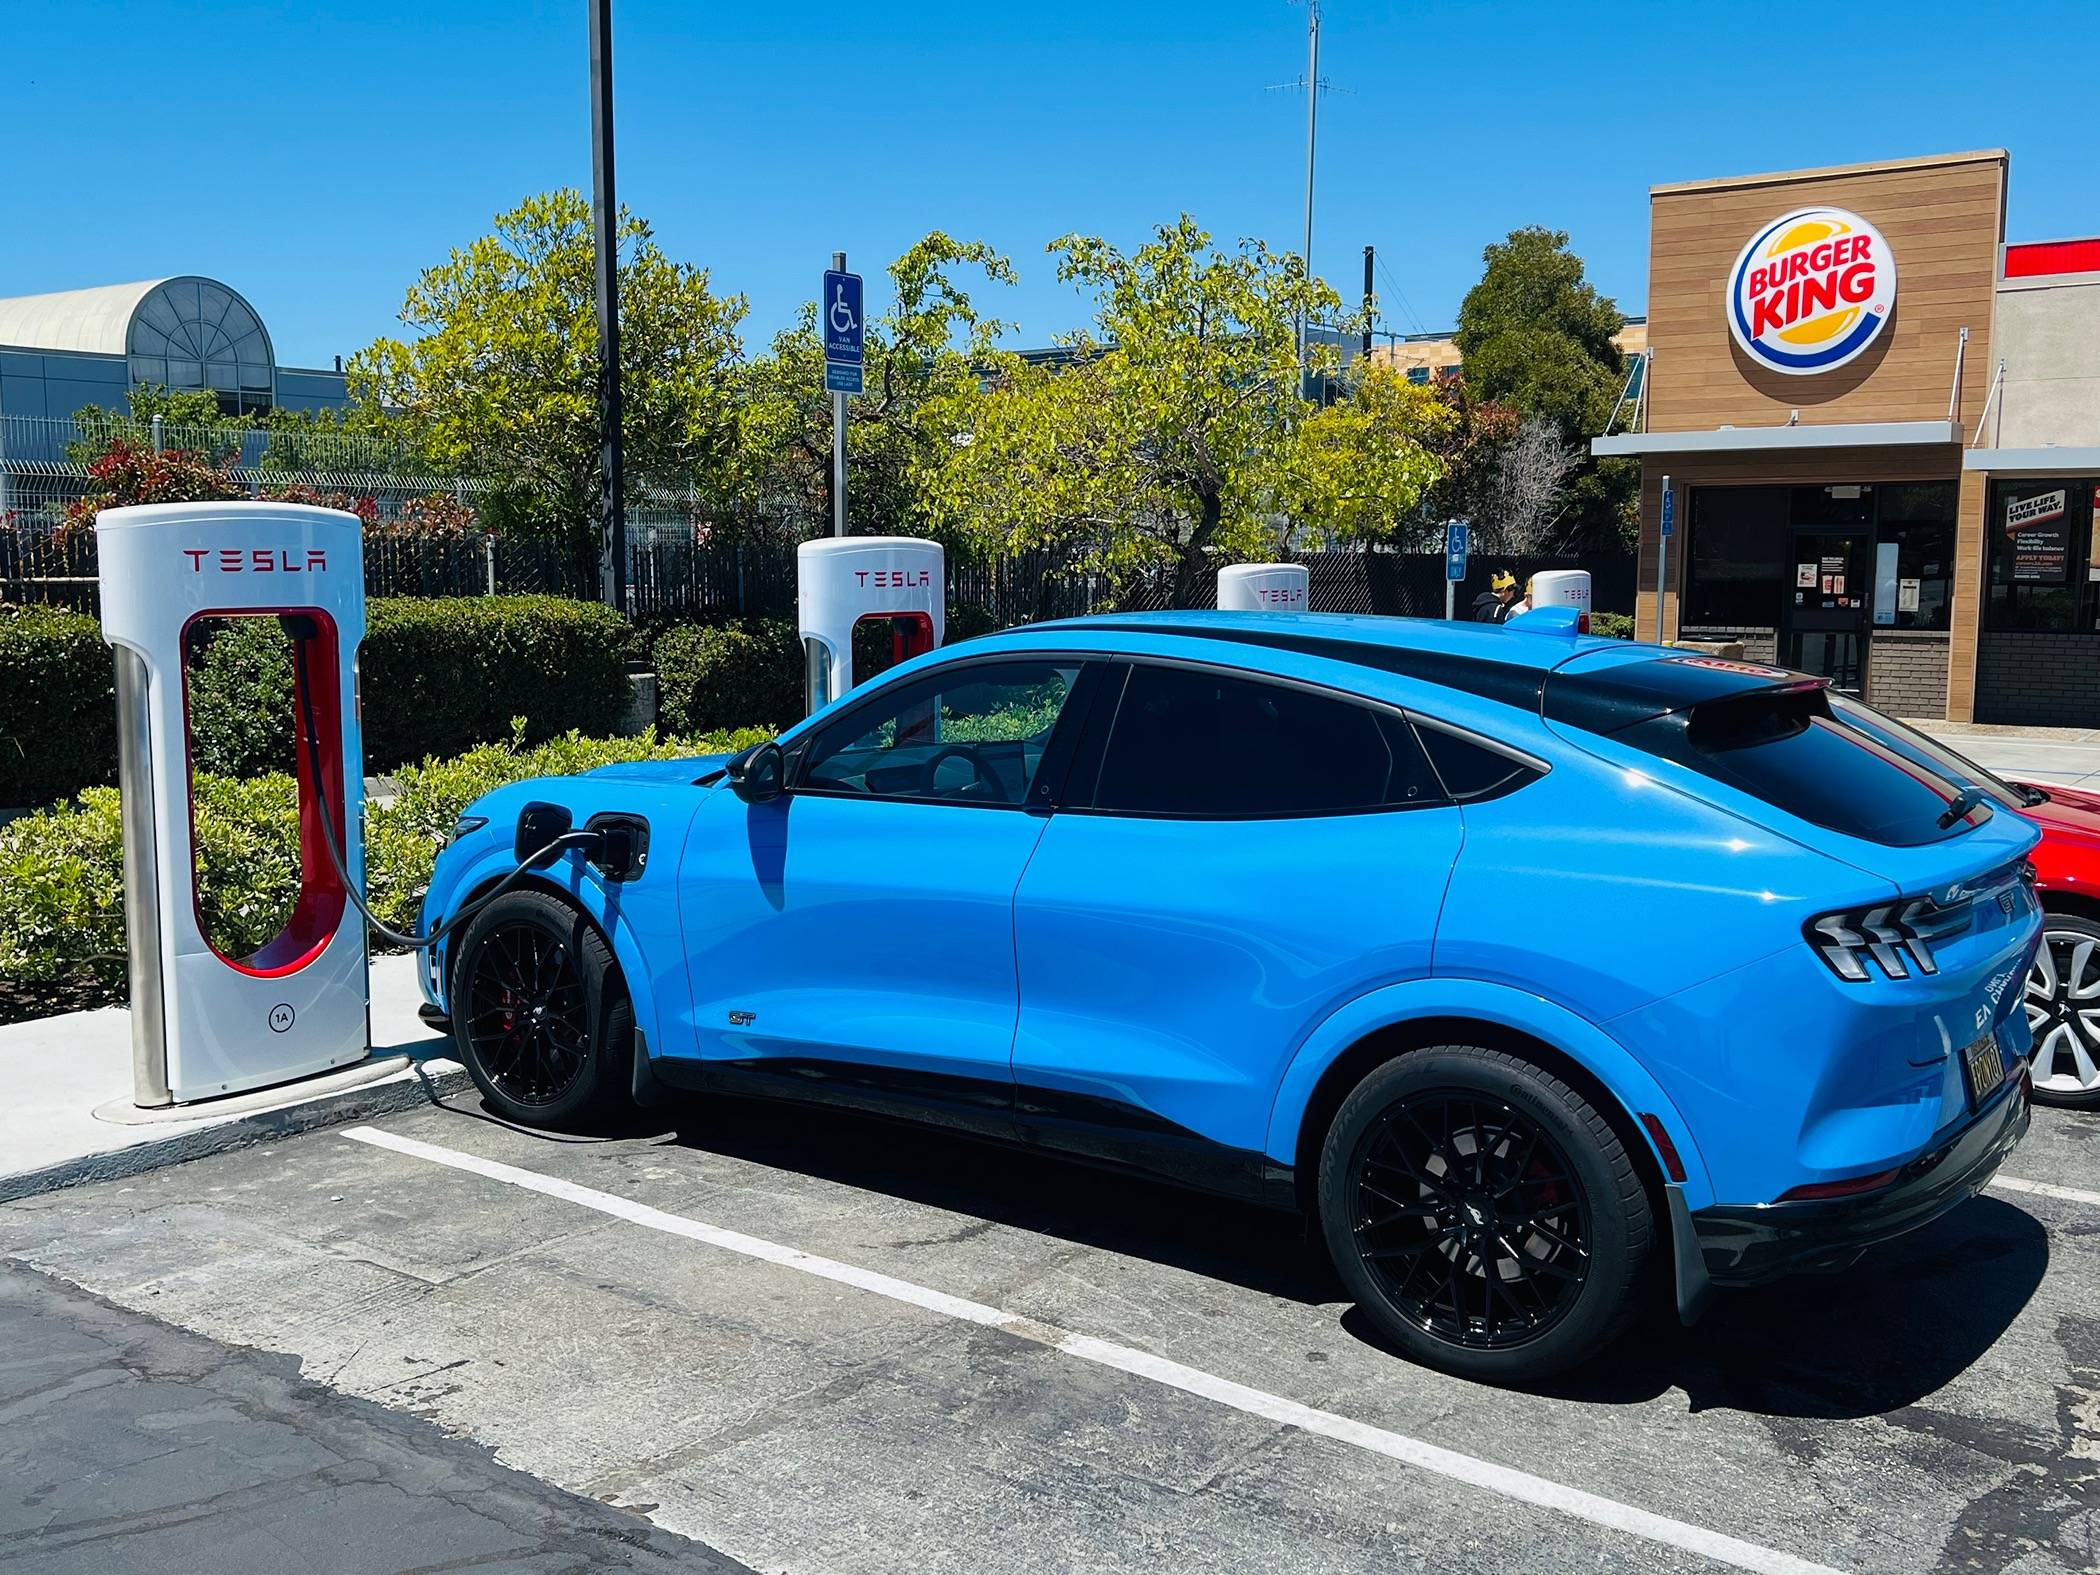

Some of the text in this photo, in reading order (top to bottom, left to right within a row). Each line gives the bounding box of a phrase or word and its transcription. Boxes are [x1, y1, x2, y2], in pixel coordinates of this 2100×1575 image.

[1749, 234, 1872, 300] BURGER
[1752, 262, 1876, 340] KING
[829, 342, 860, 352] ACCESSIBLE
[2009, 495, 2056, 514] LIVE LIFE
[2009, 501, 2062, 522] YOUR WAY.
[183, 550, 327, 572] TESLA
[854, 571, 929, 588] TESLA
[1259, 589, 1303, 602] TESLA
[275, 1012, 289, 1024] 1A
[729, 1010, 757, 1027] GT
